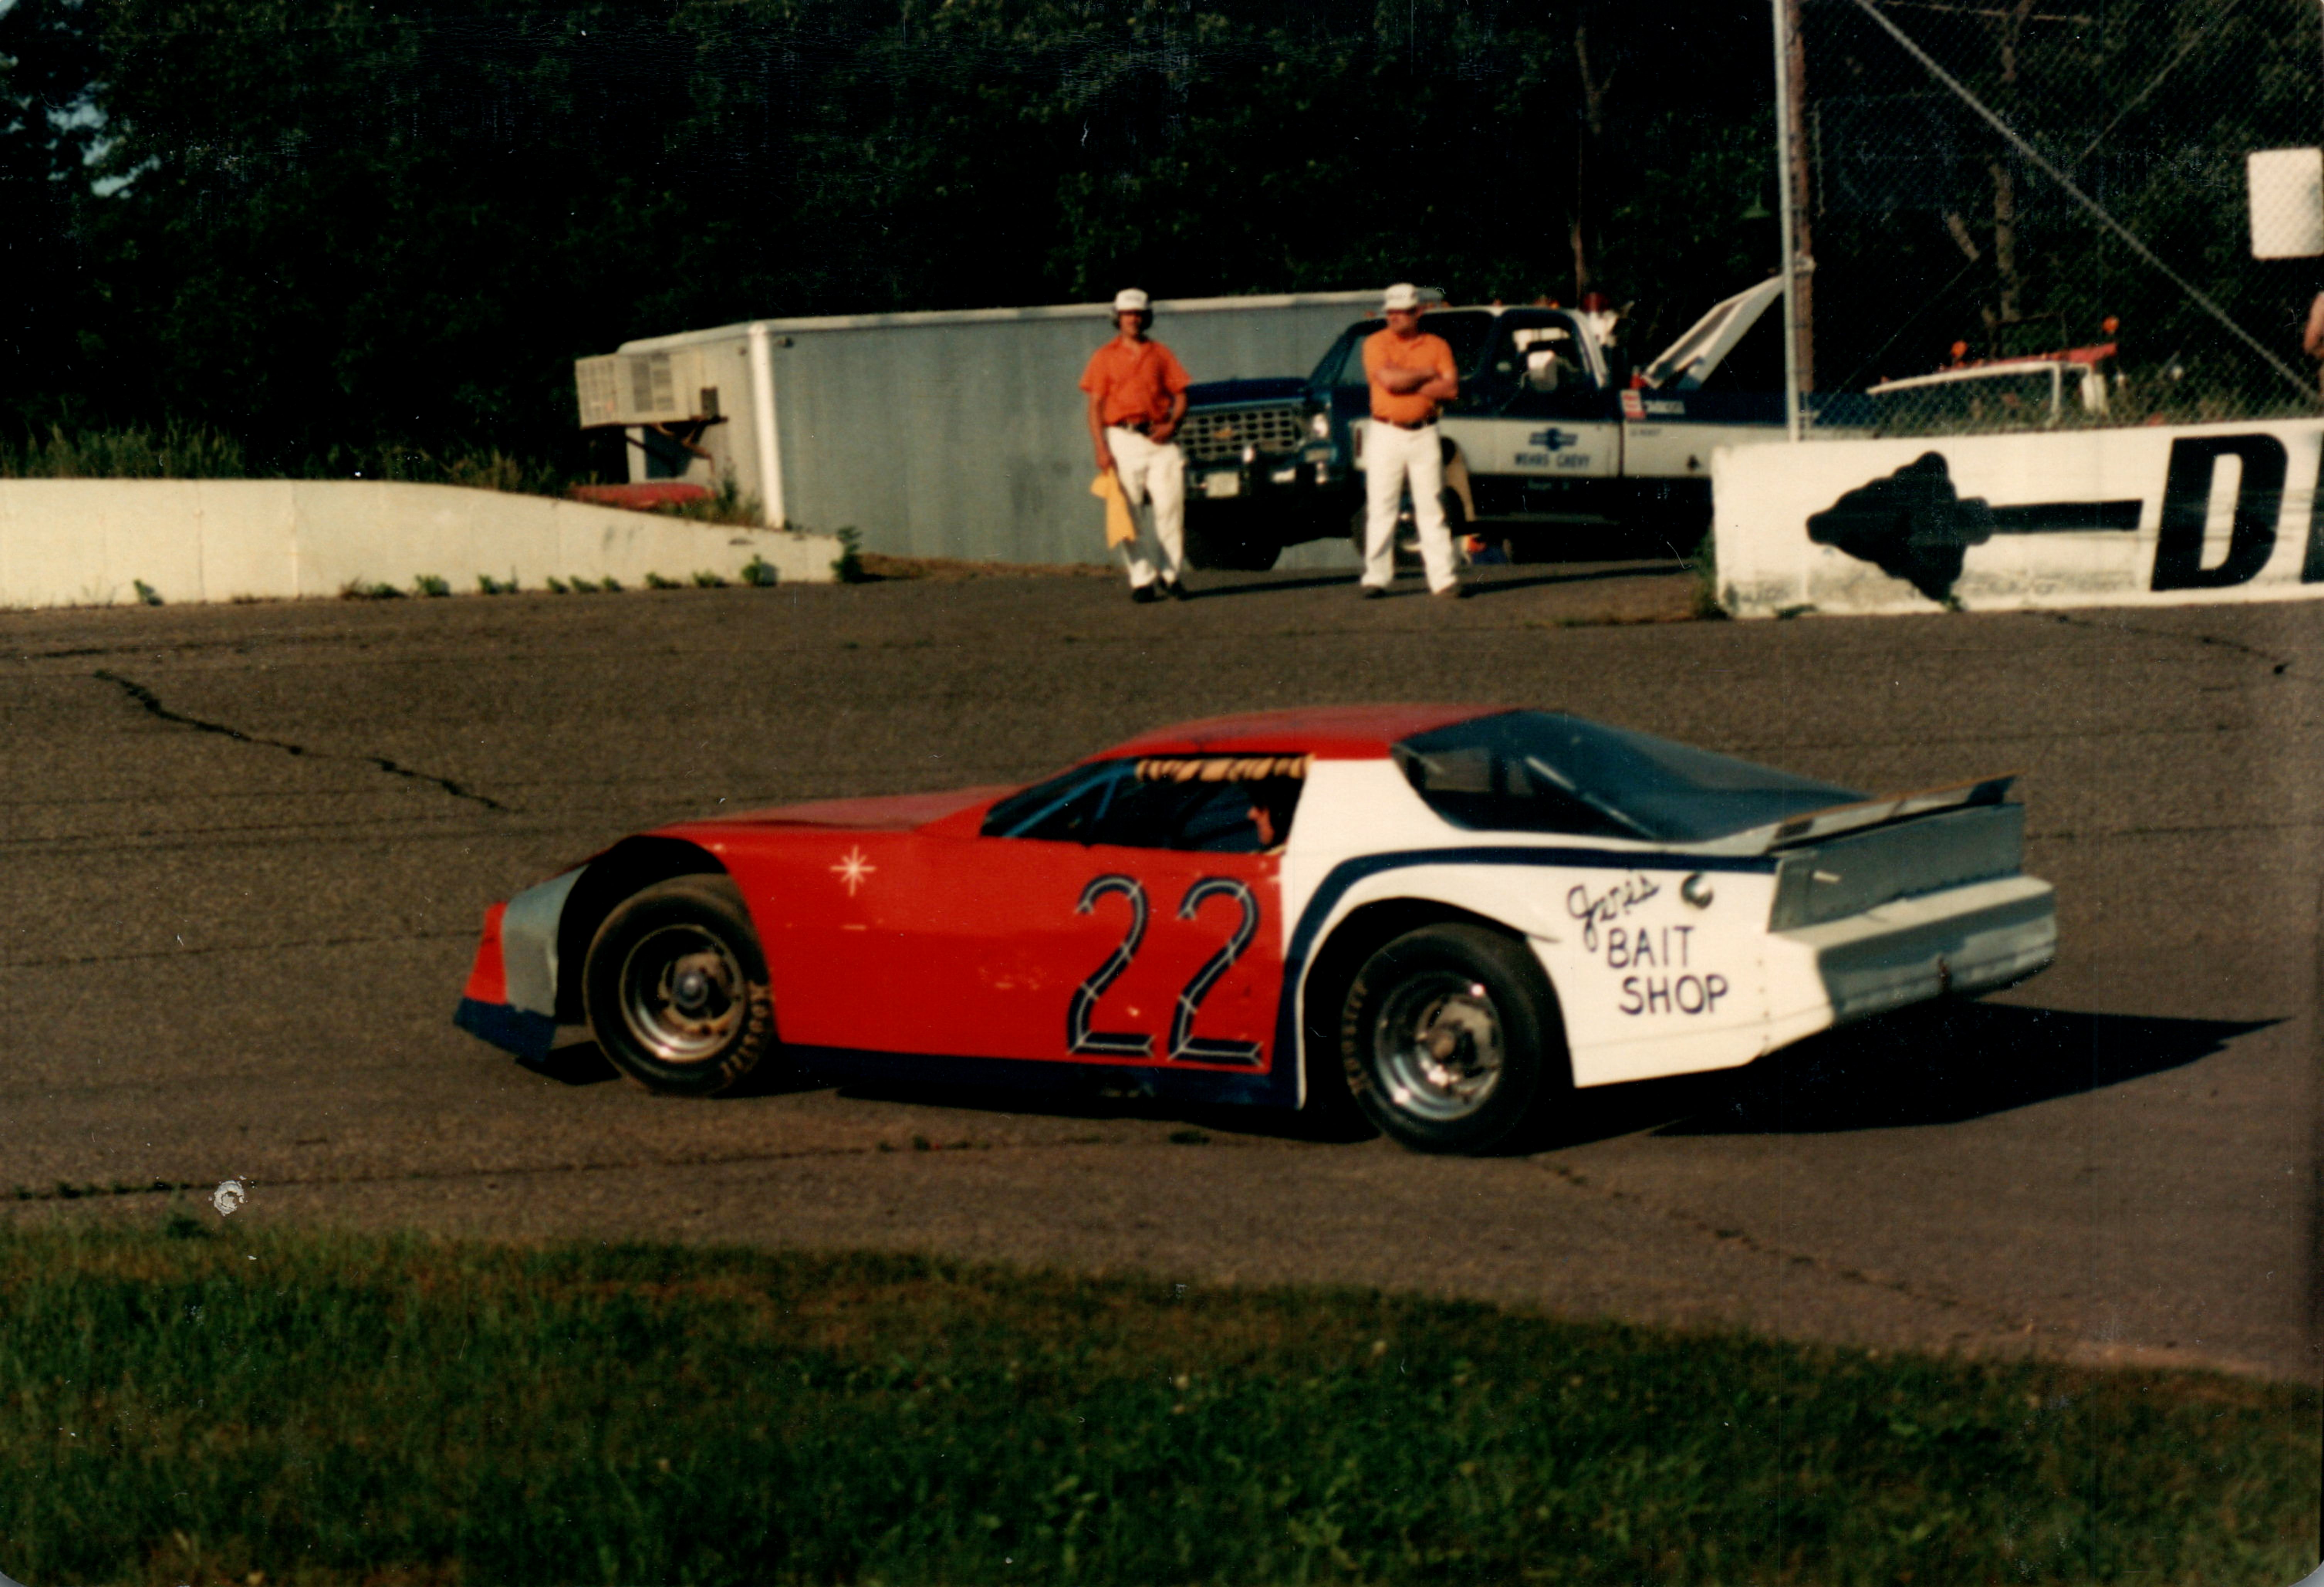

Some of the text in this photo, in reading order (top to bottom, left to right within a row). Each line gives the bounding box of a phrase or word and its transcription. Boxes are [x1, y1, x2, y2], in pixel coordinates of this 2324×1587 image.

[2150, 433, 2324, 592] D
[1066, 873, 1264, 1067] 22
[1607, 925, 1694, 969] BAIT
[1619, 973, 1729, 1016] SHOP
